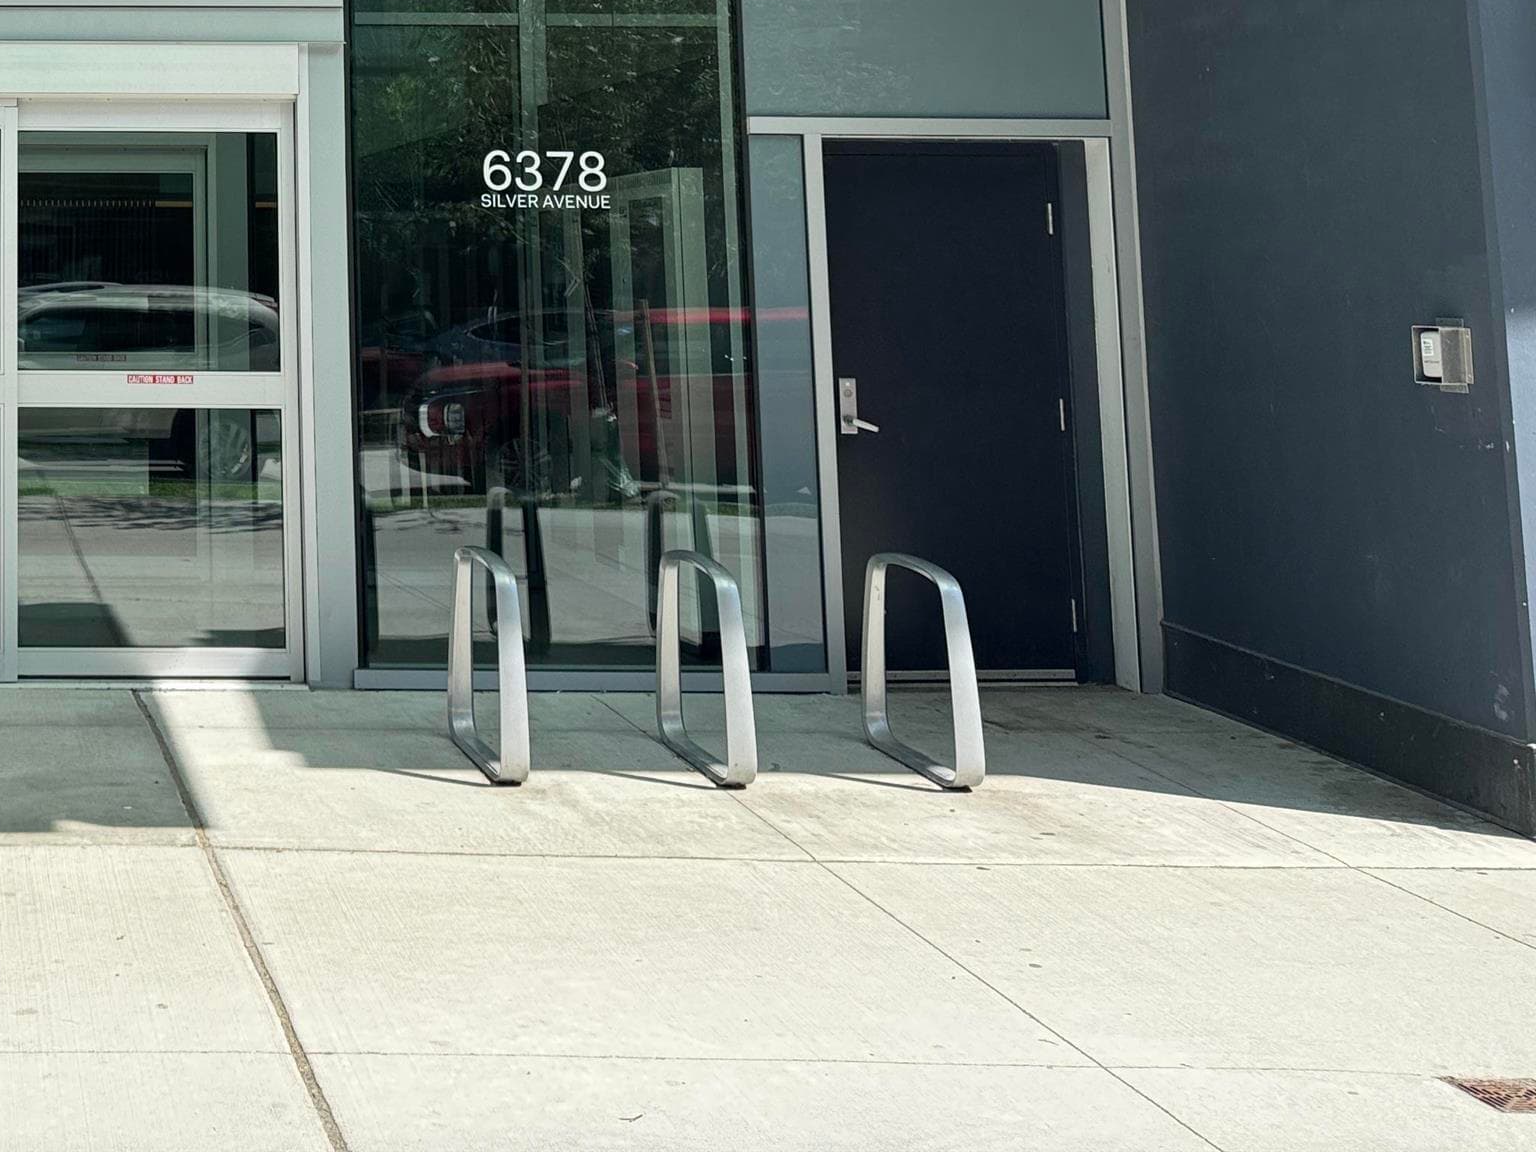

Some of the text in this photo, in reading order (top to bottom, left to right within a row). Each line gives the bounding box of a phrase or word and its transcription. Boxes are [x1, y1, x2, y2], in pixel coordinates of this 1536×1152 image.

[482, 149, 608, 193] 6378
[480, 193, 612, 210] SILVER AVENUE
[128, 375, 193, 384] CAUTION STAND BACK
